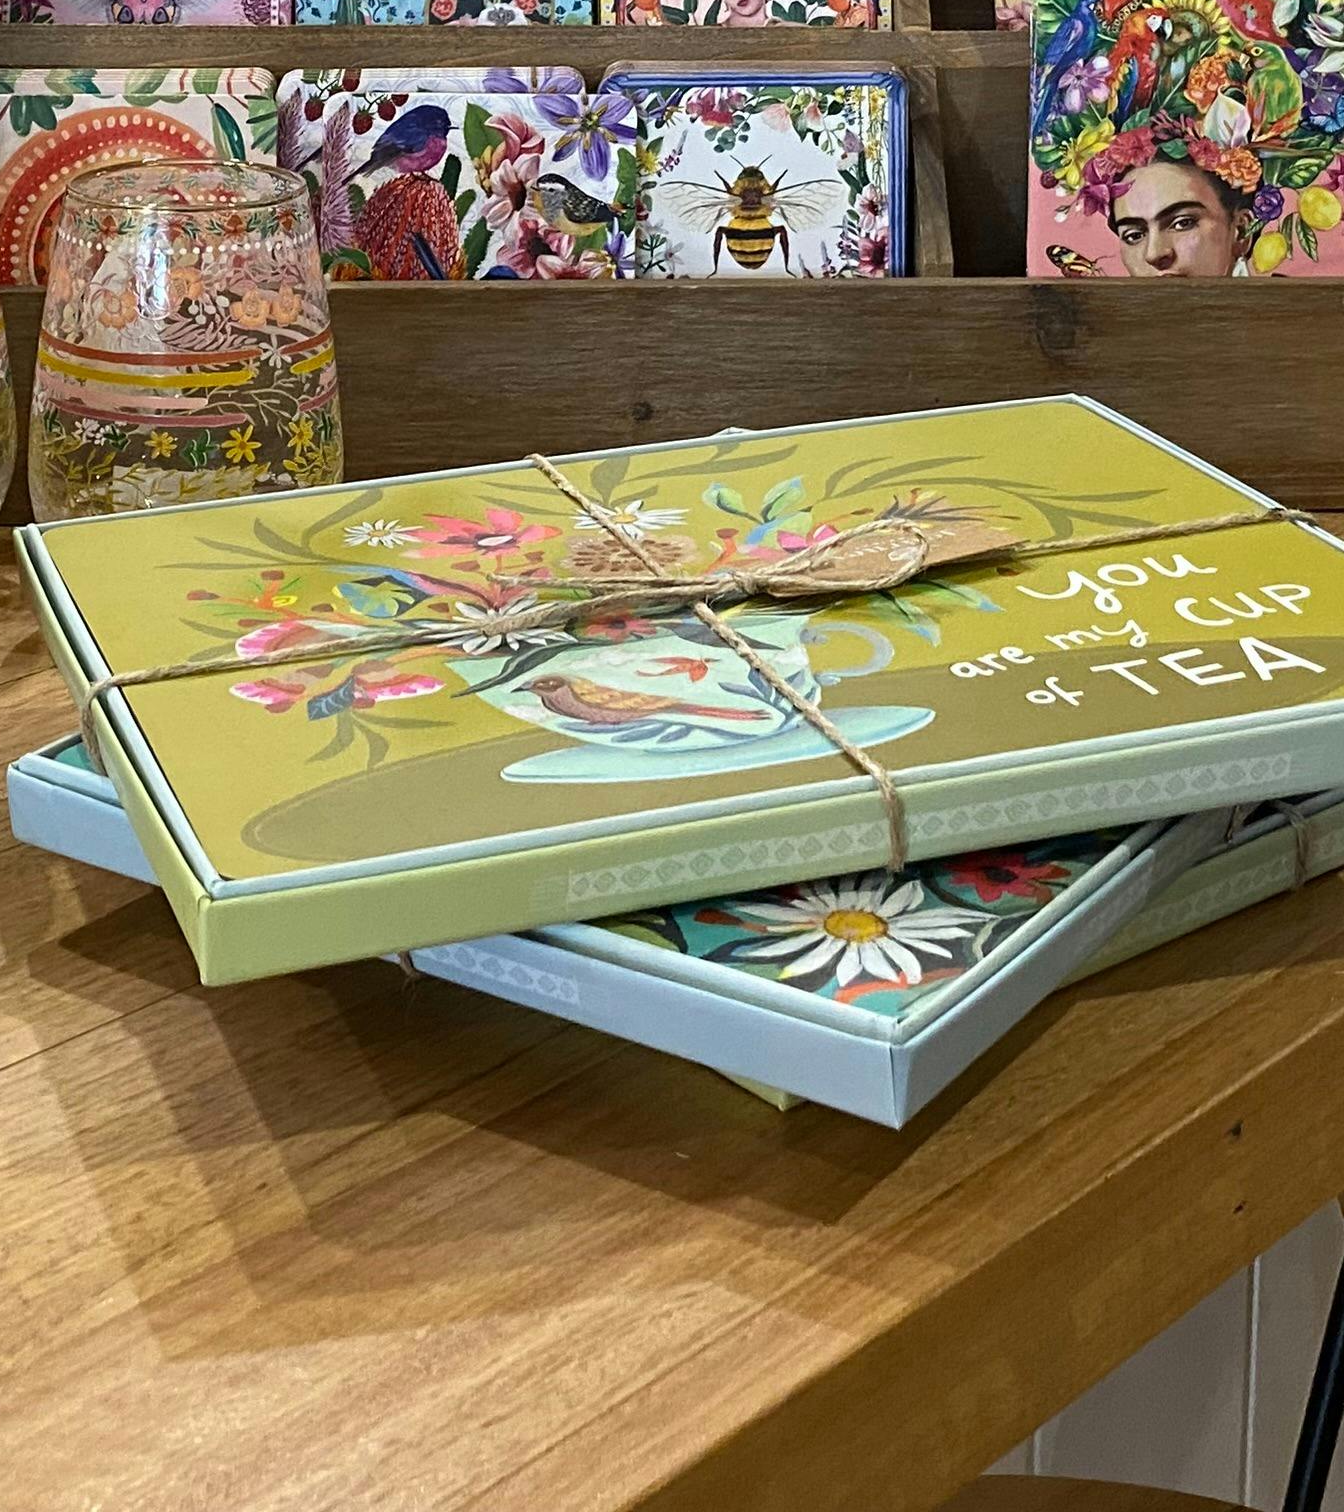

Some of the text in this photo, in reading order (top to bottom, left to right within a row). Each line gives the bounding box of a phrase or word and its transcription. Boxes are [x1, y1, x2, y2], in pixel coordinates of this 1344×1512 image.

[1016, 553, 1218, 614] you
[949, 583, 1312, 679] are my CUP
[1025, 635, 1328, 707] of TEA
